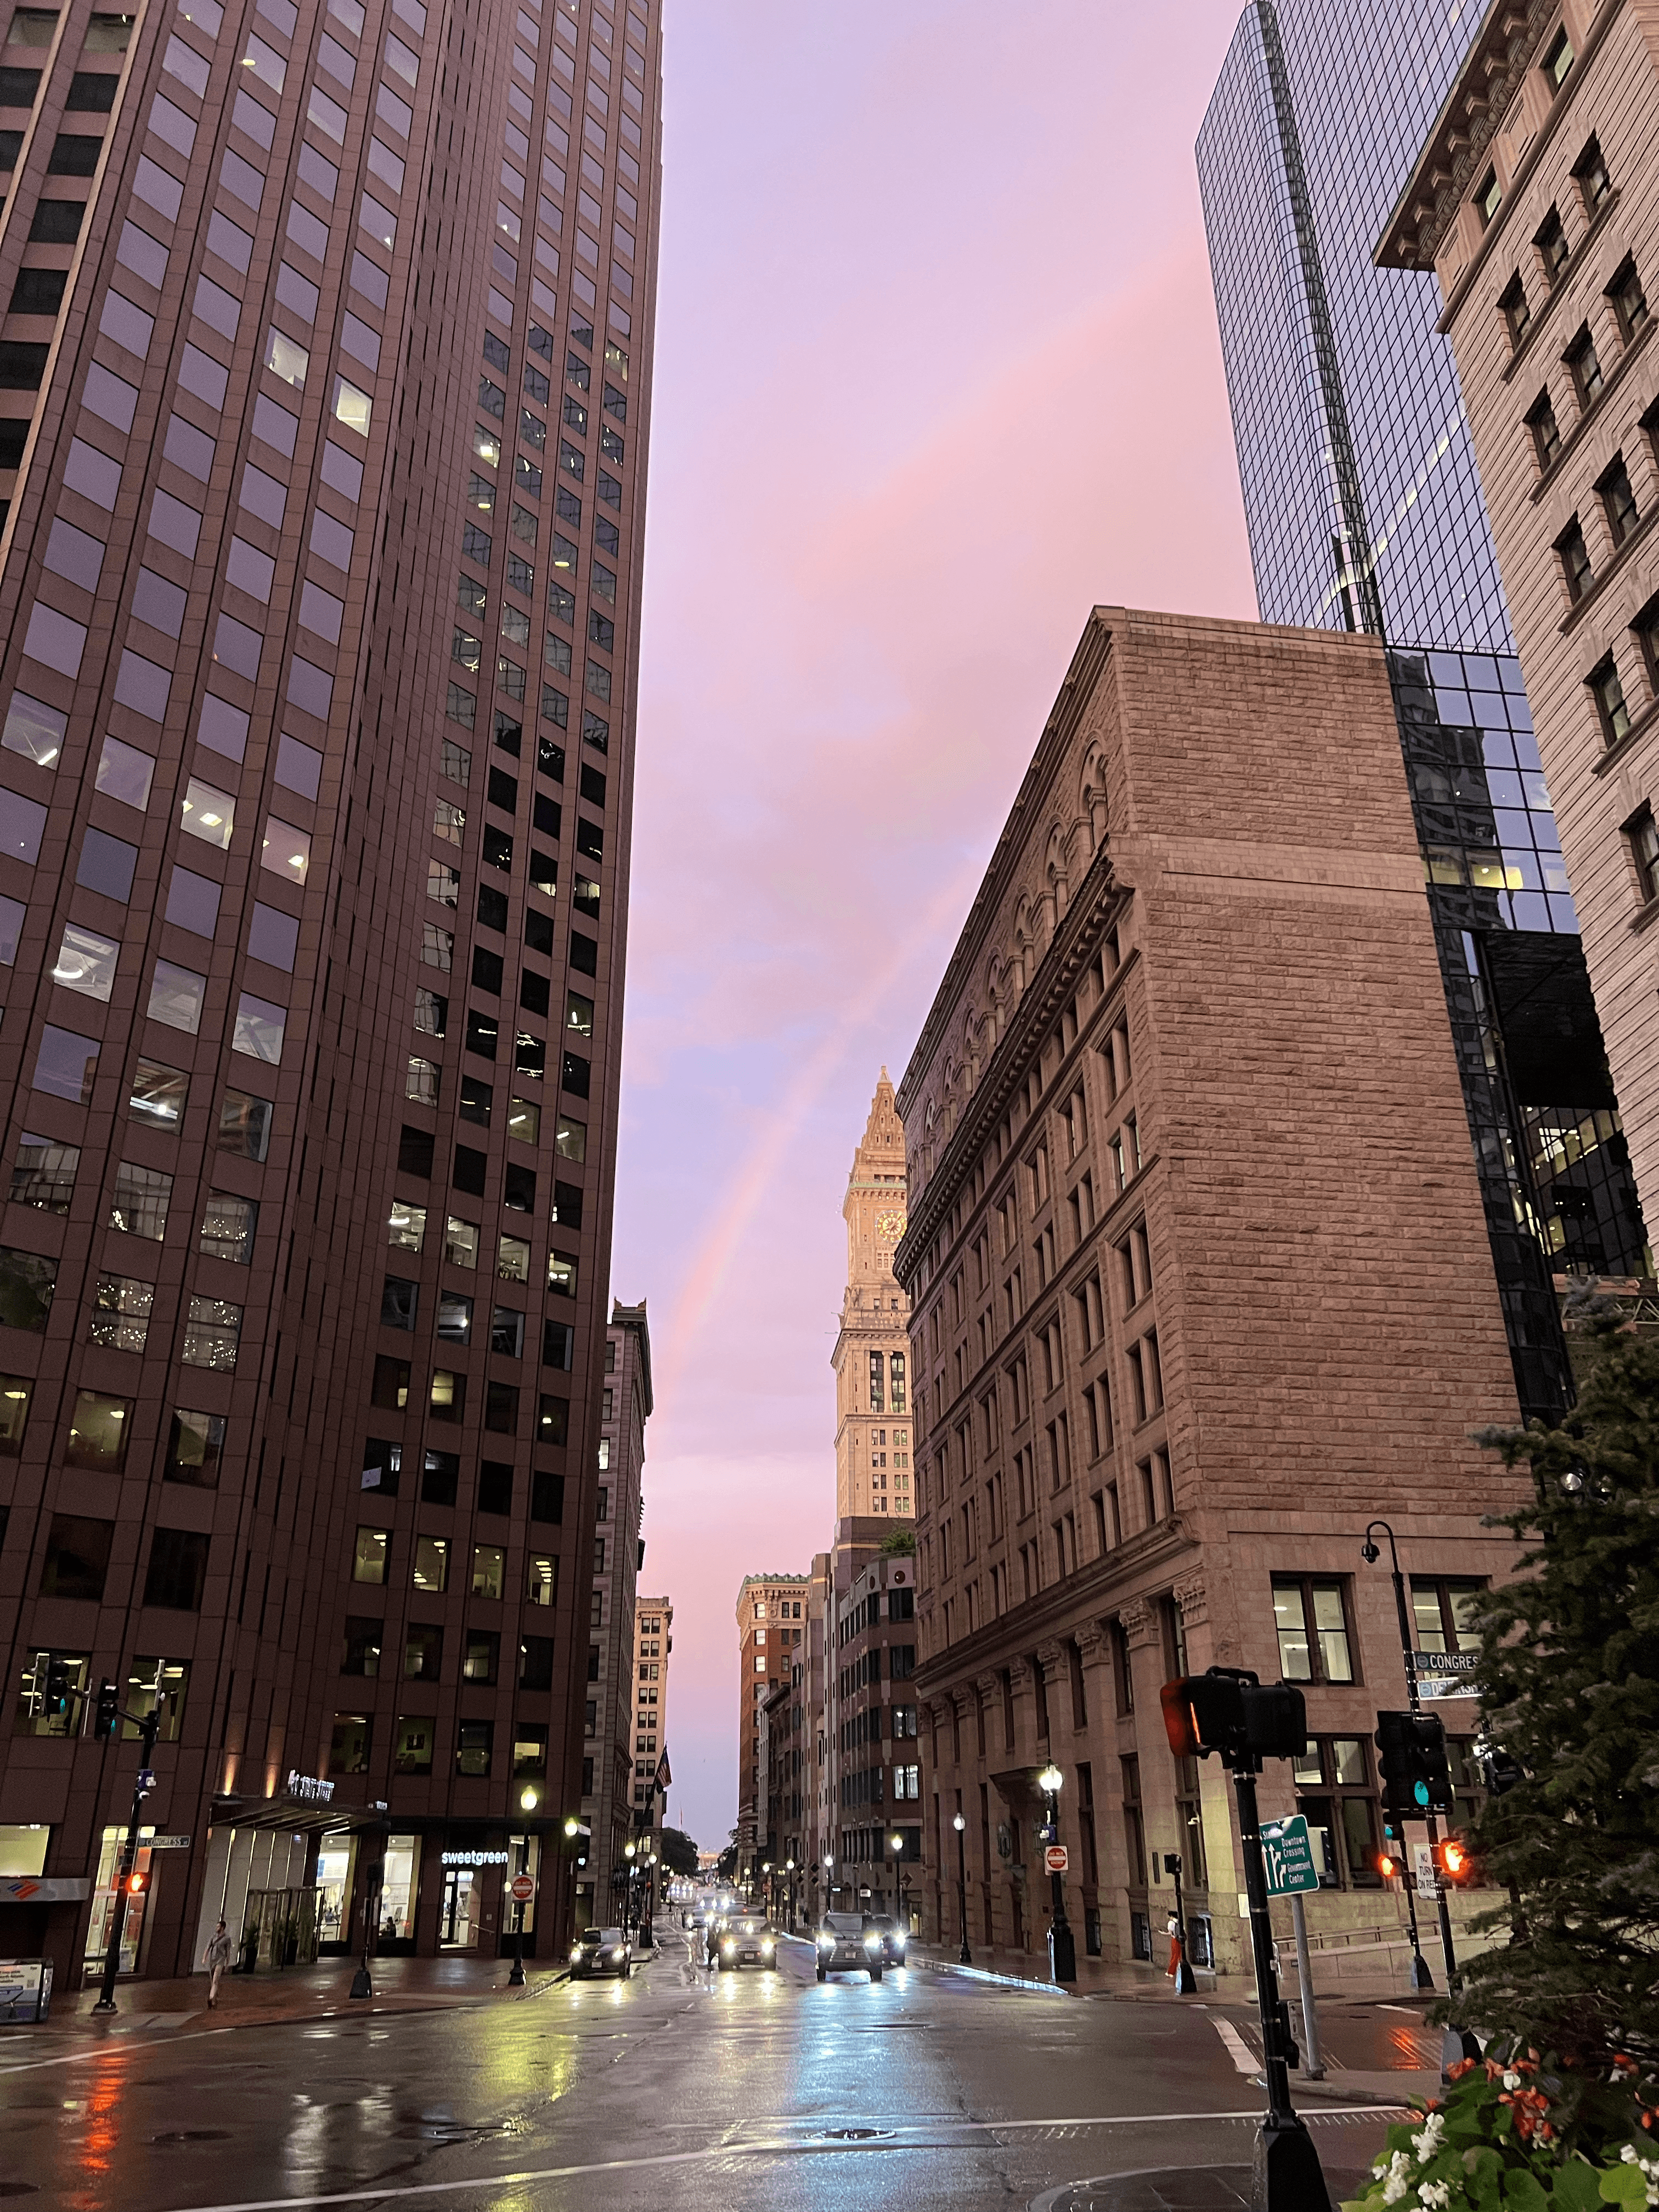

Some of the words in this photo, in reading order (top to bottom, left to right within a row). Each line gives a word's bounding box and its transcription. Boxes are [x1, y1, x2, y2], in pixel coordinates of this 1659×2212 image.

[1430, 1655, 1479, 1670] CONGRES
[146, 1837, 181, 1846] CONGRESS
[1281, 1836, 1306, 1848] Downtown
[1283, 1847, 1305, 1858] Crossing
[442, 1850, 509, 1866] sweetgreen
[1420, 1853, 1427, 1863] NO
[1419, 1866, 1433, 1876] TURN
[1289, 1874, 1305, 1884] Center
[1418, 1879, 1426, 1889] ON
